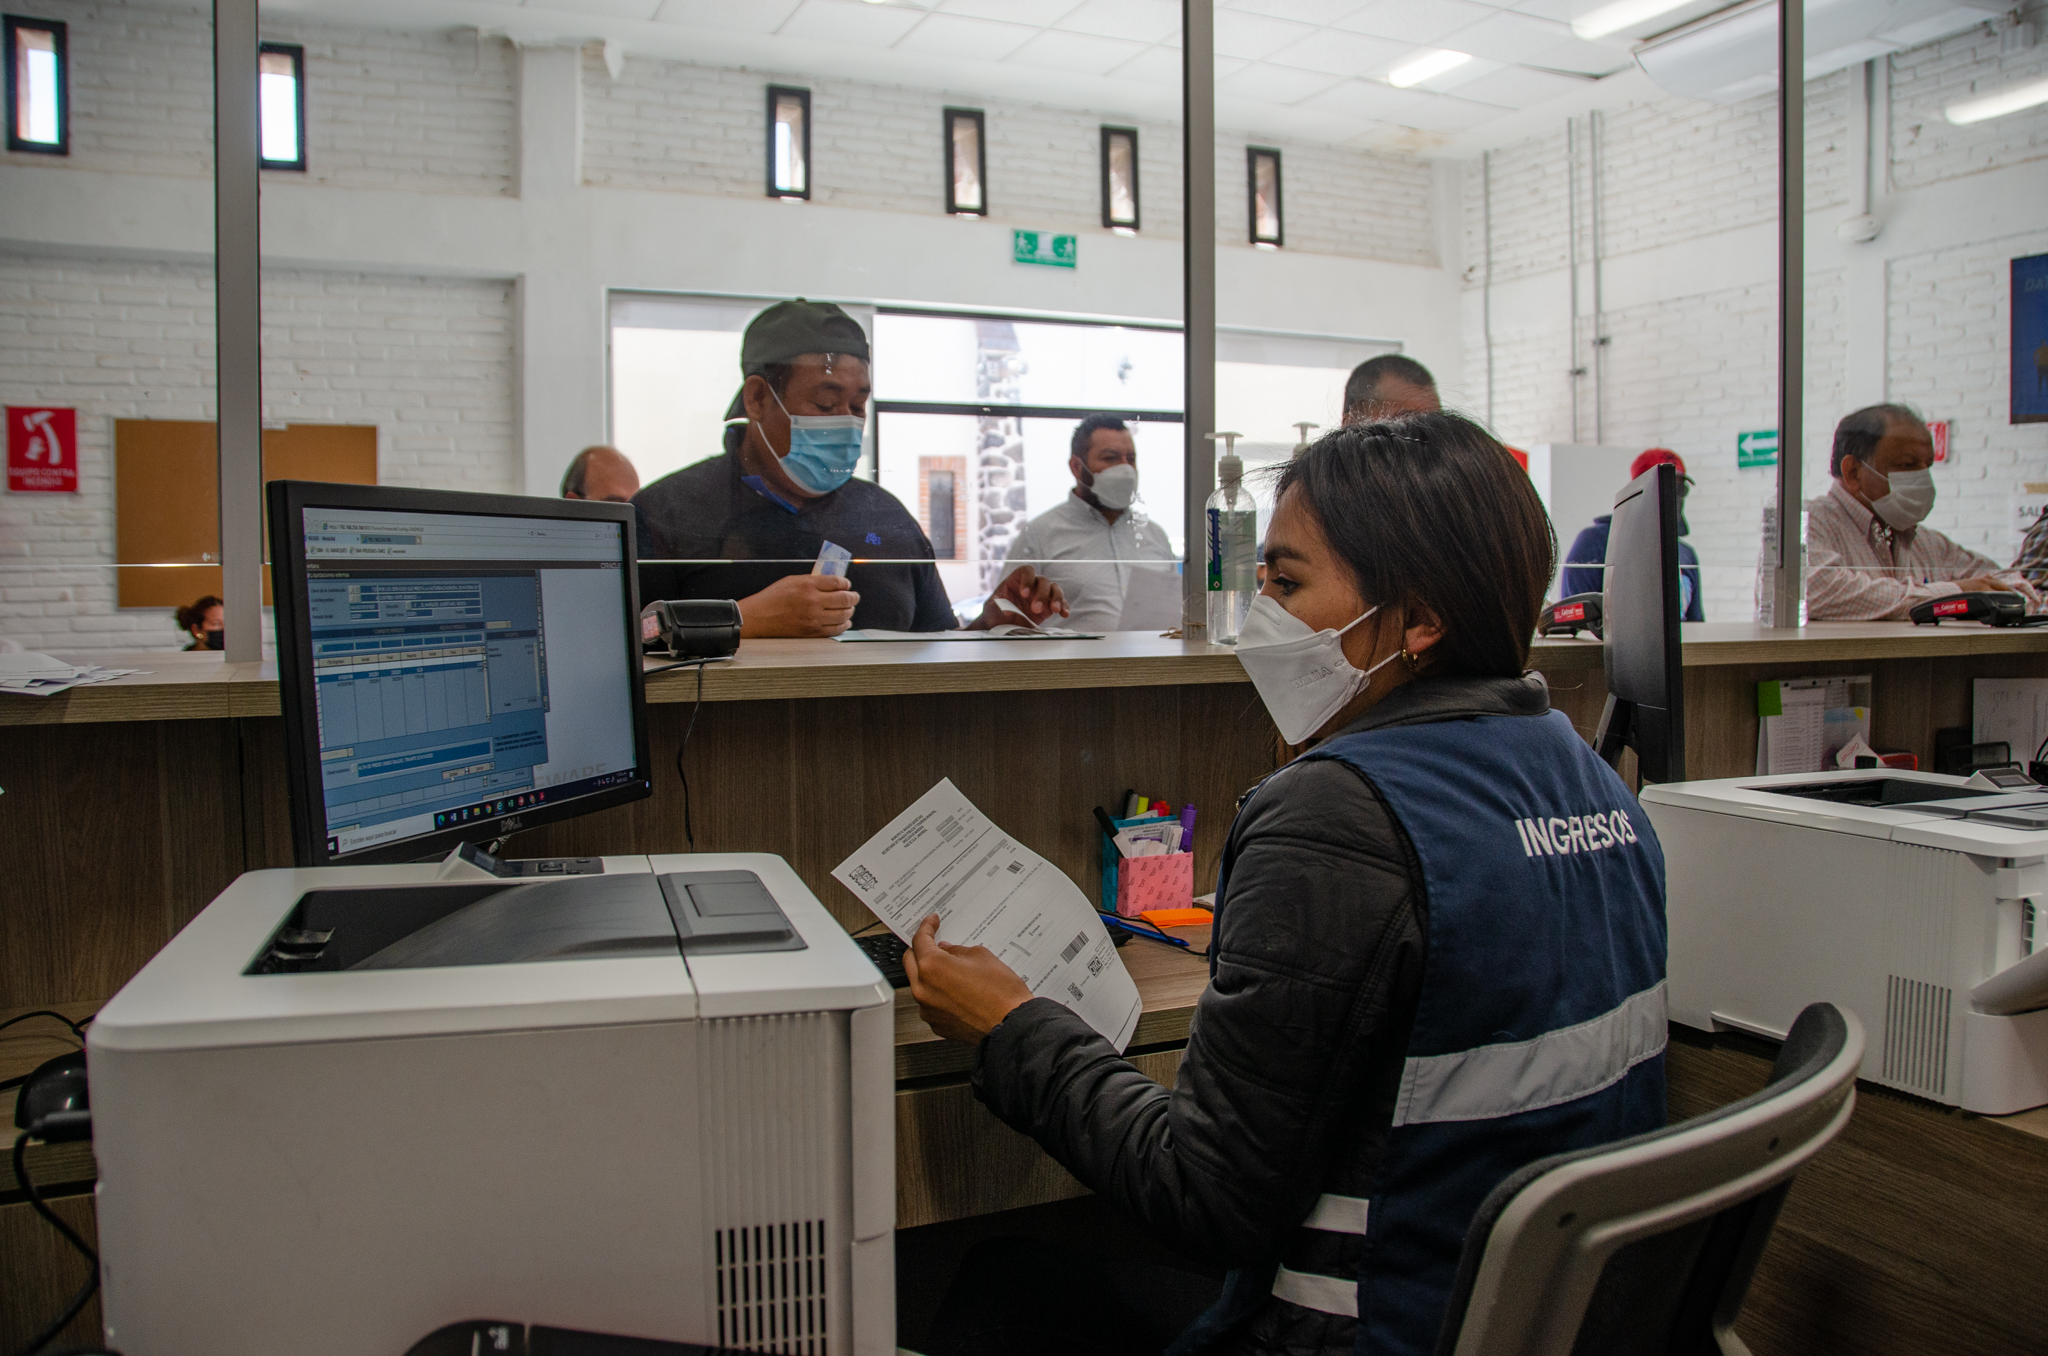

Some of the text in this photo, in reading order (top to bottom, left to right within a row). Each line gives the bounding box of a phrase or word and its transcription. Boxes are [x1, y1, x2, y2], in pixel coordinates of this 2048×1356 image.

[42, 468, 75, 478] CONTRA
[501, 816, 522, 832] DELL
[1515, 809, 1637, 857] INGRESOS
